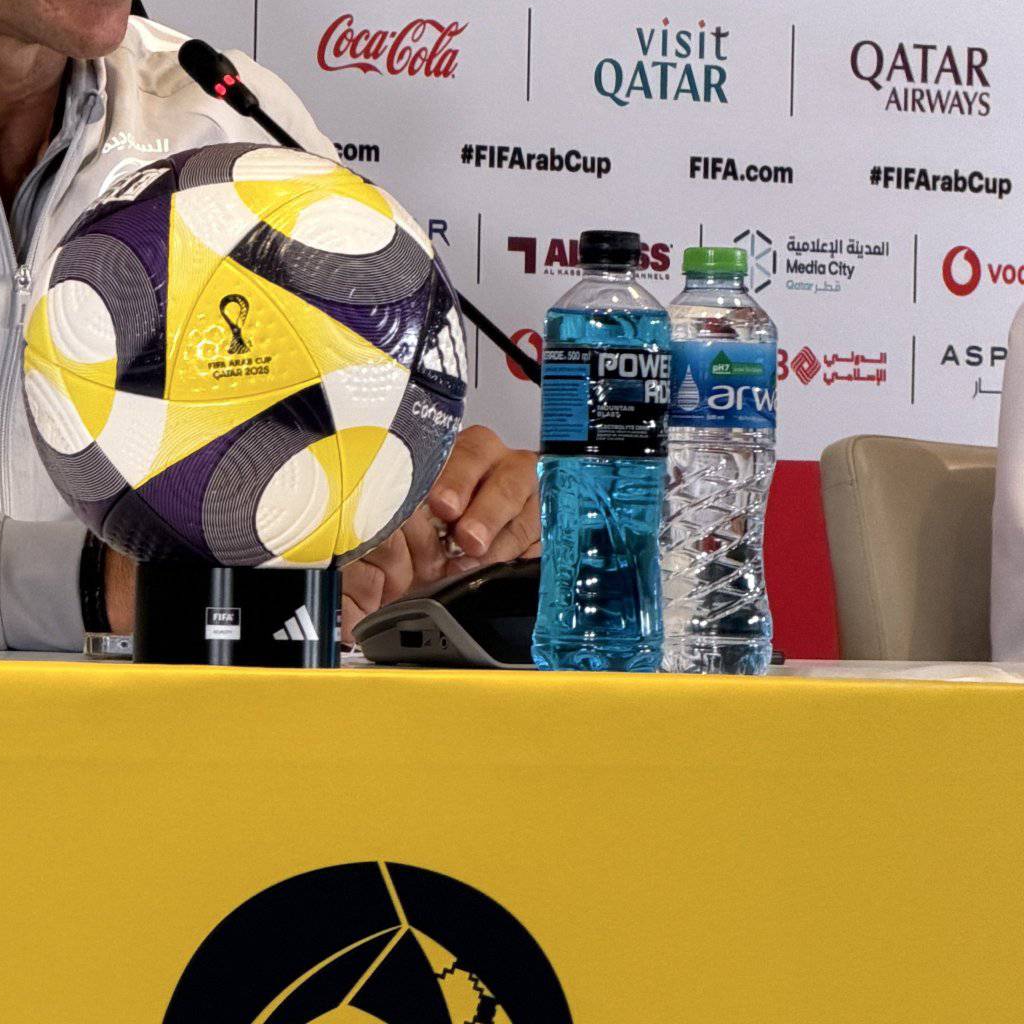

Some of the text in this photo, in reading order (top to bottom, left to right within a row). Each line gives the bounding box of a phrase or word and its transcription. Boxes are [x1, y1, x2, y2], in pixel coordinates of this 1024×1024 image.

[317, 14, 467, 78] Coca-Cola
[636, 18, 729, 61] visit
[851, 41, 990, 90] QATAR
[594, 58, 728, 106] QATAR
[885, 87, 990, 116] AIRWAYS
[461, 144, 611, 178] #FIFArabCup
[690, 156, 793, 183] FIFA.com
[870, 166, 1011, 199] #FIFArabCup
[847, 239, 889, 258] المدينة
[787, 259, 855, 279] Media City
[229, 358, 253, 367] ARAB
[255, 356, 272, 364] CUP
[245, 366, 270, 375] 2025
[708, 385, 776, 411] arw
